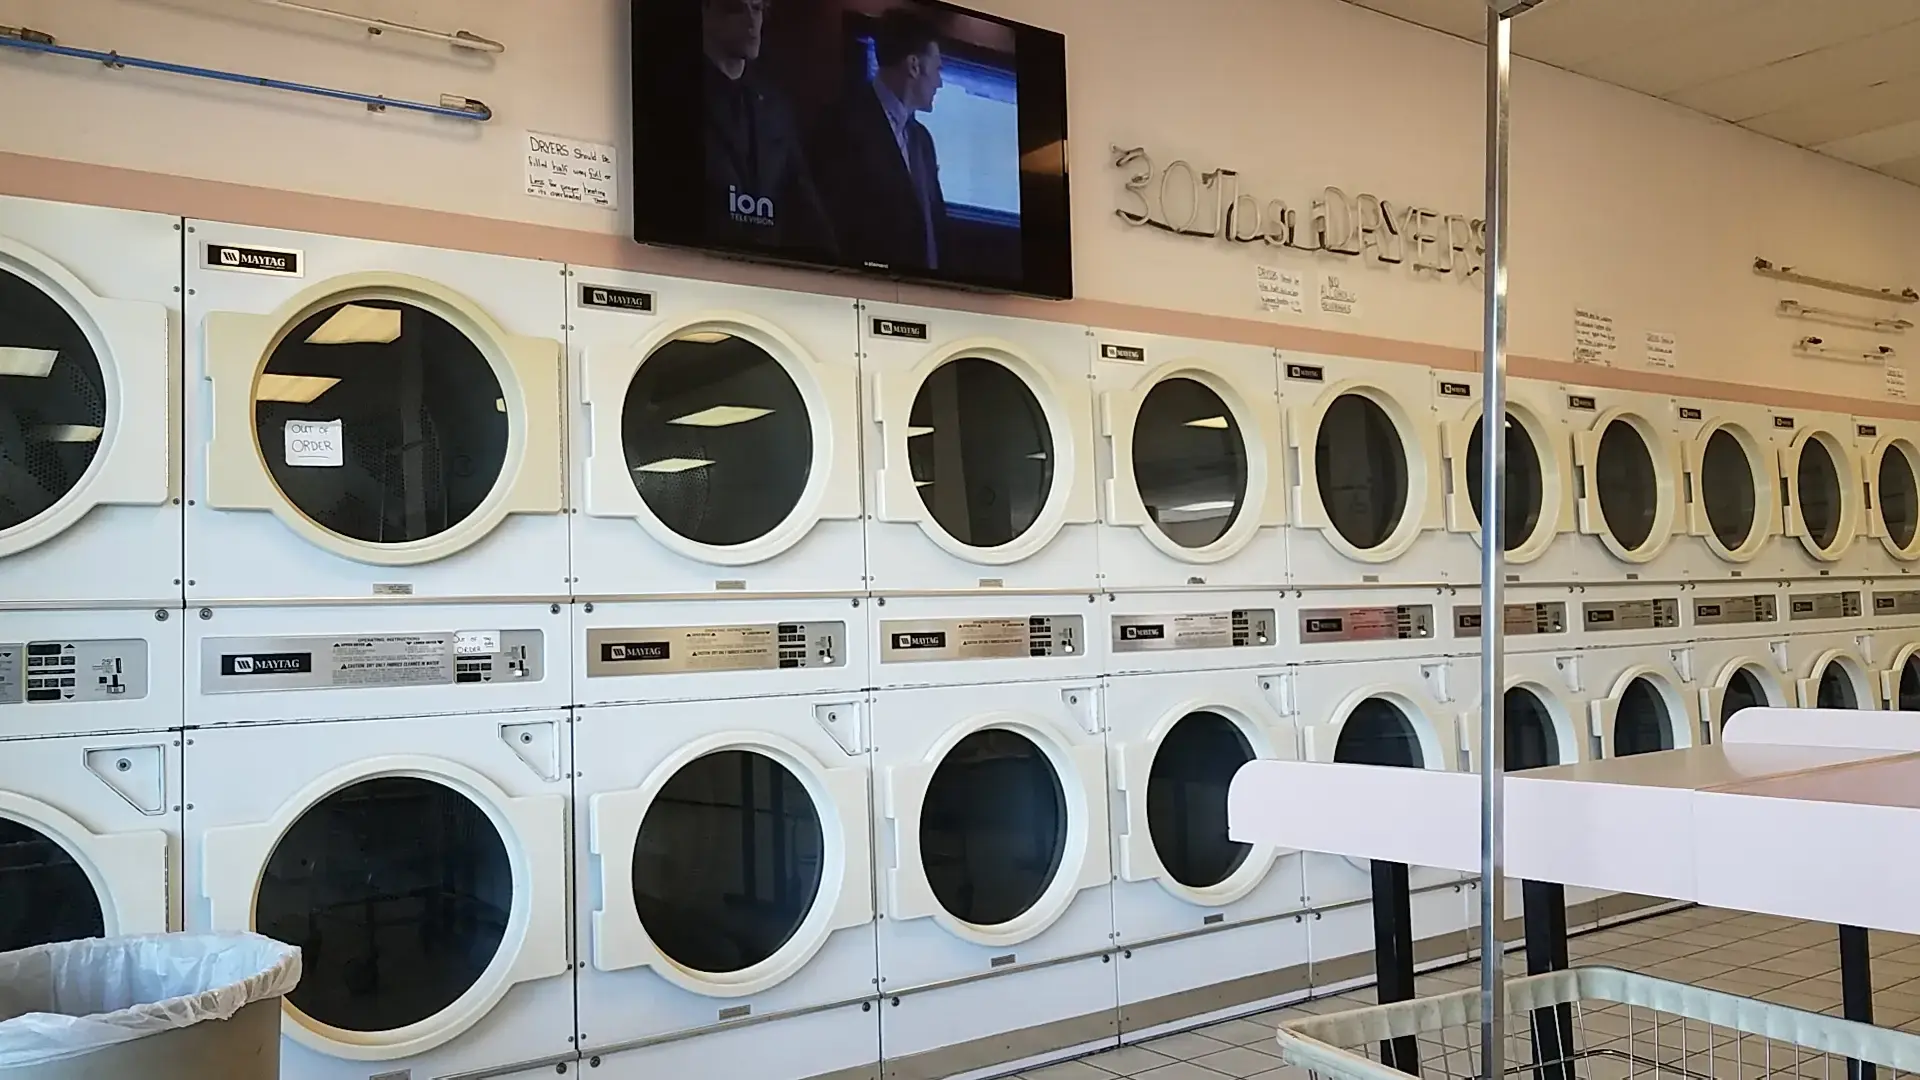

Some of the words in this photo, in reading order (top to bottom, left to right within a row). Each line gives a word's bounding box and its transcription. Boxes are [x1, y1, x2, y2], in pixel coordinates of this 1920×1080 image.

[529, 136, 569, 156] DRYERS
[729, 184, 774, 218] ion
[730, 213, 775, 226] TELEVISION
[241, 253, 286, 267] MAYTAG
[608, 294, 643, 306] MAYTAG
[892, 325, 920, 335] MAYTAG
[291, 439, 334, 453] ORDER
[911, 636, 940, 645] MAYTAG
[627, 646, 661, 656] MAYTAG
[255, 659, 300, 669] MAYTAG
